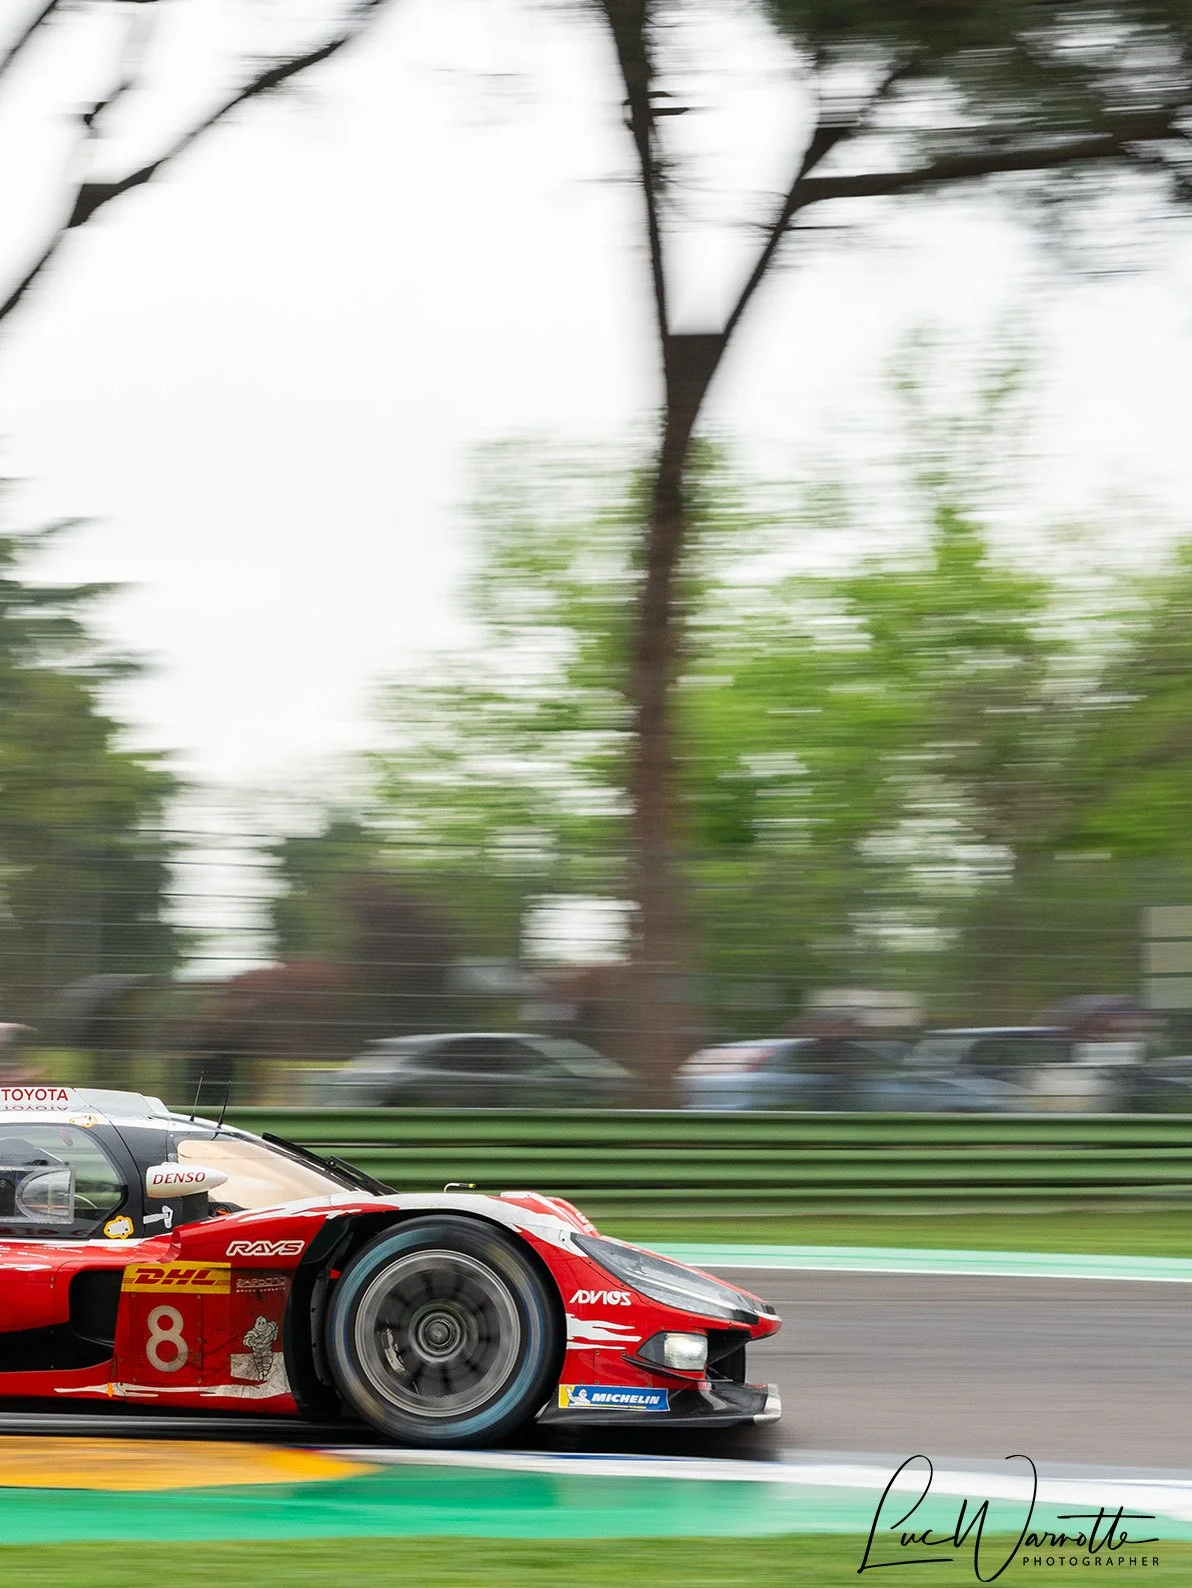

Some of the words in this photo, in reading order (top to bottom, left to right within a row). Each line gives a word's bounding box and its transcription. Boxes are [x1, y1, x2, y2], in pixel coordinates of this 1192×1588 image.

[1, 1088, 68, 1101] TOYOTA
[153, 1172, 206, 1185] DENSO
[226, 1240, 305, 1256] RAYS
[134, 1268, 217, 1286] DHL
[146, 1305, 189, 1372] 8
[591, 1393, 660, 1405] MICHELIN
